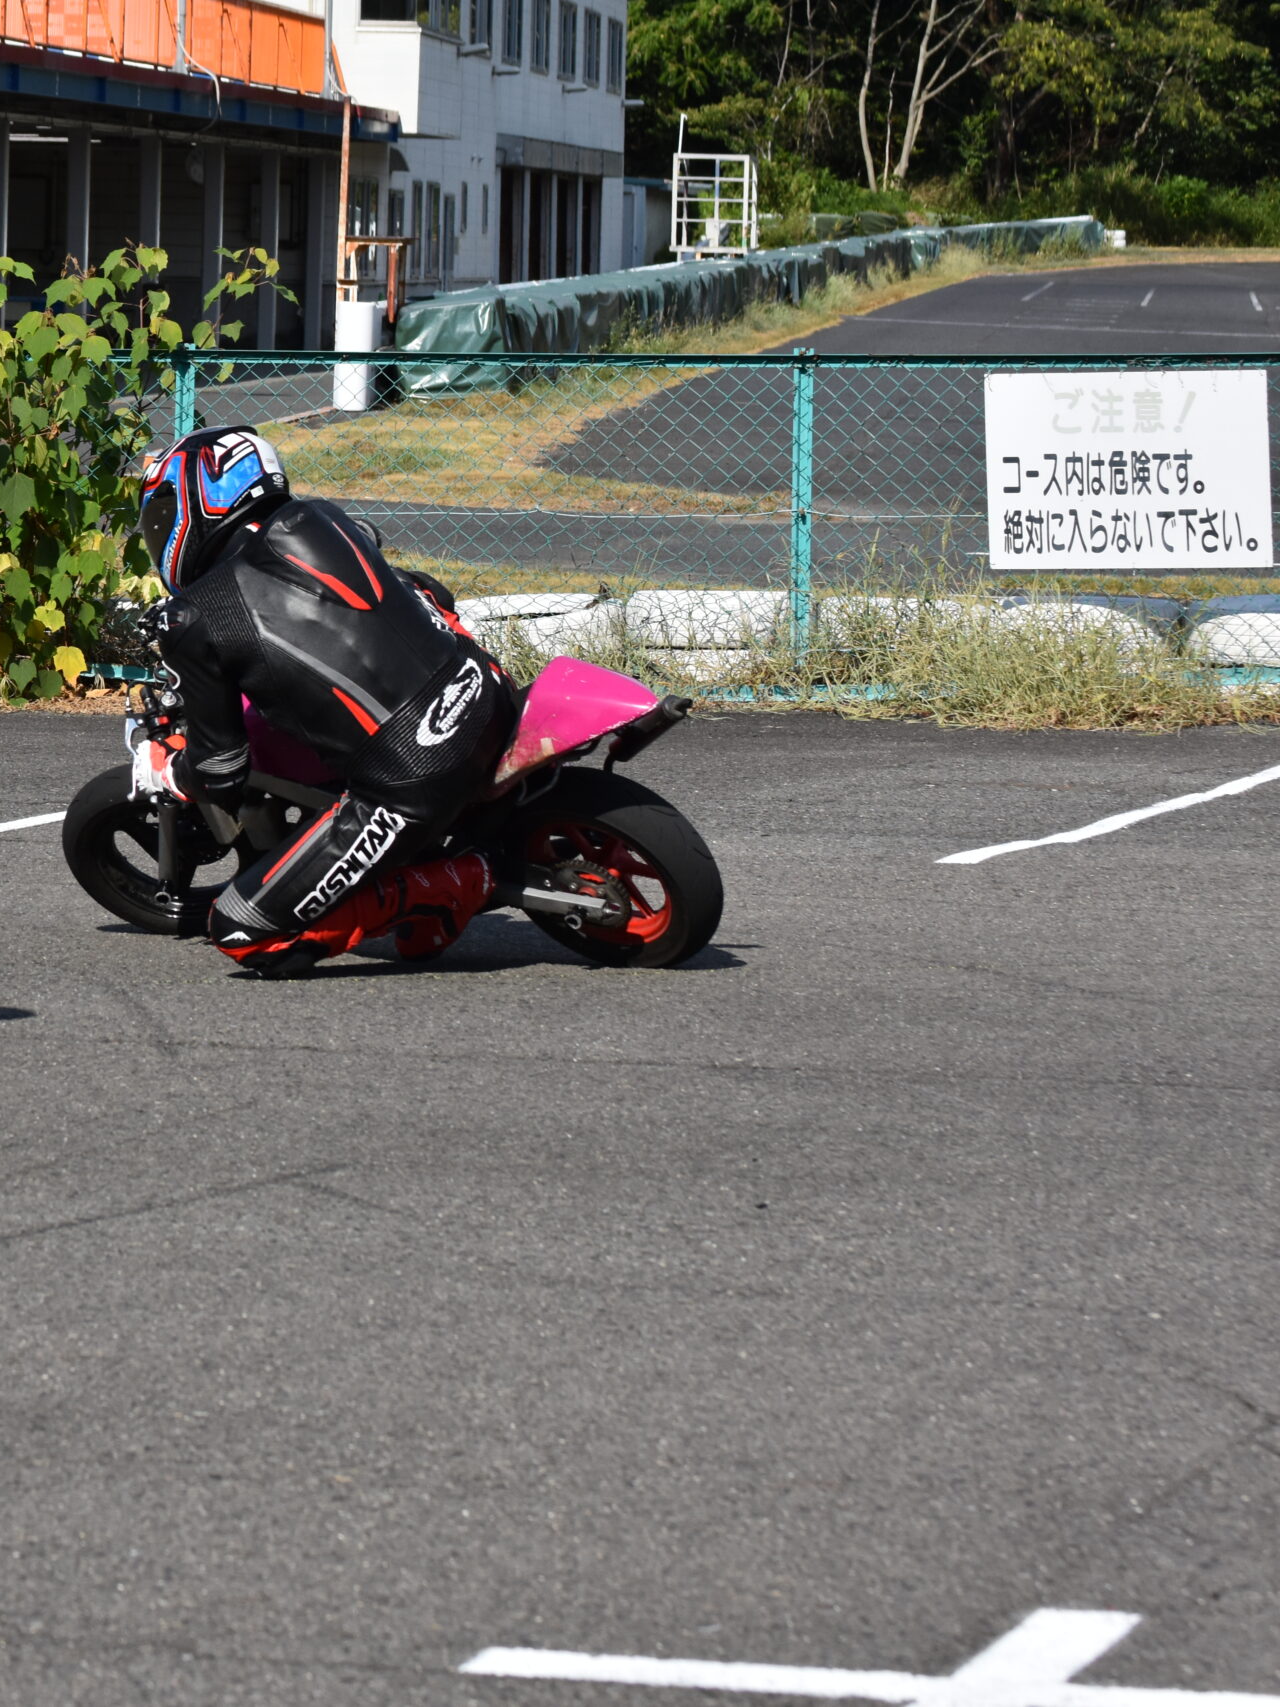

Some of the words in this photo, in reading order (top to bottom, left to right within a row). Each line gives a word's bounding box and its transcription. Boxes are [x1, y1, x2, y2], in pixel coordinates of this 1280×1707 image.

[1002, 449, 1205, 496] コース内は危険です。
[1003, 508, 1258, 554] 絶対に入らないで下さい。
